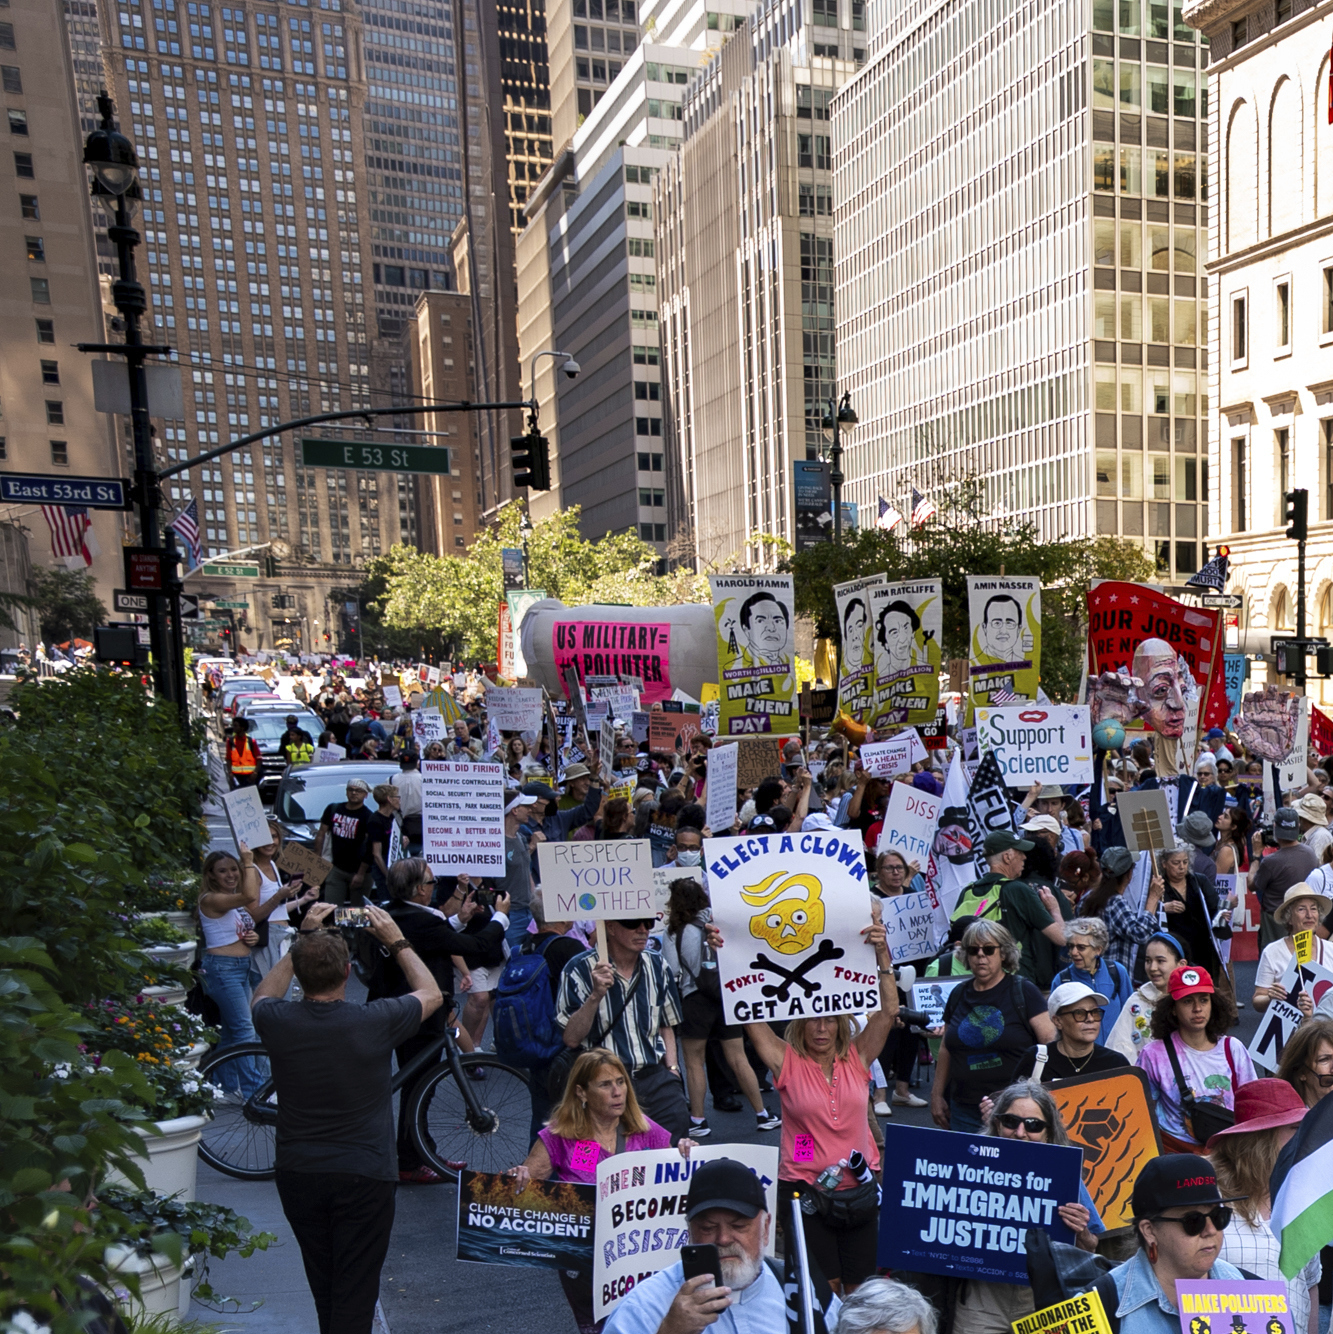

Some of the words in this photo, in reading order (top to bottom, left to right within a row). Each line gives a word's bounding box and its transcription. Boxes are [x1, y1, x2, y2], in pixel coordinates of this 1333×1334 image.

[344, 447, 353, 463] E
[363, 448, 383, 465] 53
[391, 450, 409, 467] St
[8, 482, 48, 497] East
[53, 484, 92, 500] 53rd
[97, 486, 116, 501] St
[716, 580, 755, 588] HAROLD
[756, 580, 790, 589] HAMM
[873, 589, 888, 598] JIM
[890, 585, 935, 596] RATCLIFFE
[974, 582, 997, 590] AMIN
[999, 582, 1034, 590] NASSER
[121, 597, 147, 607] ONE
[1093, 609, 1133, 633] OUR
[1141, 614, 1197, 645] JOBS
[557, 625, 576, 650] US
[727, 679, 771, 699] MAKE
[878, 681, 913, 702] MAKE
[746, 700, 790, 714] THEM
[891, 697, 927, 709] THEM
[731, 717, 767, 734] PAY
[876, 711, 904, 727] PAY
[924, 727, 938, 737] GO
[990, 713, 1065, 751] Support
[876, 761, 898, 770] CRISIS
[881, 753, 907, 763] HEALTH
[426, 764, 450, 772] WHEN
[455, 764, 469, 772] DID
[473, 765, 500, 773] FIRING
[426, 854, 502, 864] BILLIONAIRES!!
[555, 842, 644, 864] RESPECT
[710, 836, 769, 880] ELECT
[779, 836, 794, 853] A
[800, 834, 868, 882] CLOWN
[570, 867, 633, 887] YOUR
[889, 893, 929, 915] ICE
[907, 927, 929, 941] DAY
[724, 973, 765, 993] TOXIC
[834, 966, 877, 985] TOXIC
[734, 1000, 777, 1022] GET
[788, 997, 805, 1016] A
[812, 989, 878, 1014] CIRCUS
[979, 1145, 1000, 1158] NYIC
[600, 1166, 646, 1201] WHEN
[915, 1158, 953, 1179] New
[957, 1163, 1022, 1188] Yorkers
[1026, 1172, 1052, 1192] for
[901, 1181, 1057, 1225] IMMIGRANT
[469, 1203, 522, 1219] CLIMATE
[523, 1209, 575, 1223] CHANGE
[580, 1215, 591, 1225] IS
[468, 1213, 495, 1228] NO
[499, 1217, 590, 1238] ACCIDENT
[1181, 1293, 1220, 1314] MAKE
[1221, 1294, 1288, 1314] POLLUTERS
[1071, 1313, 1096, 1334] THE
